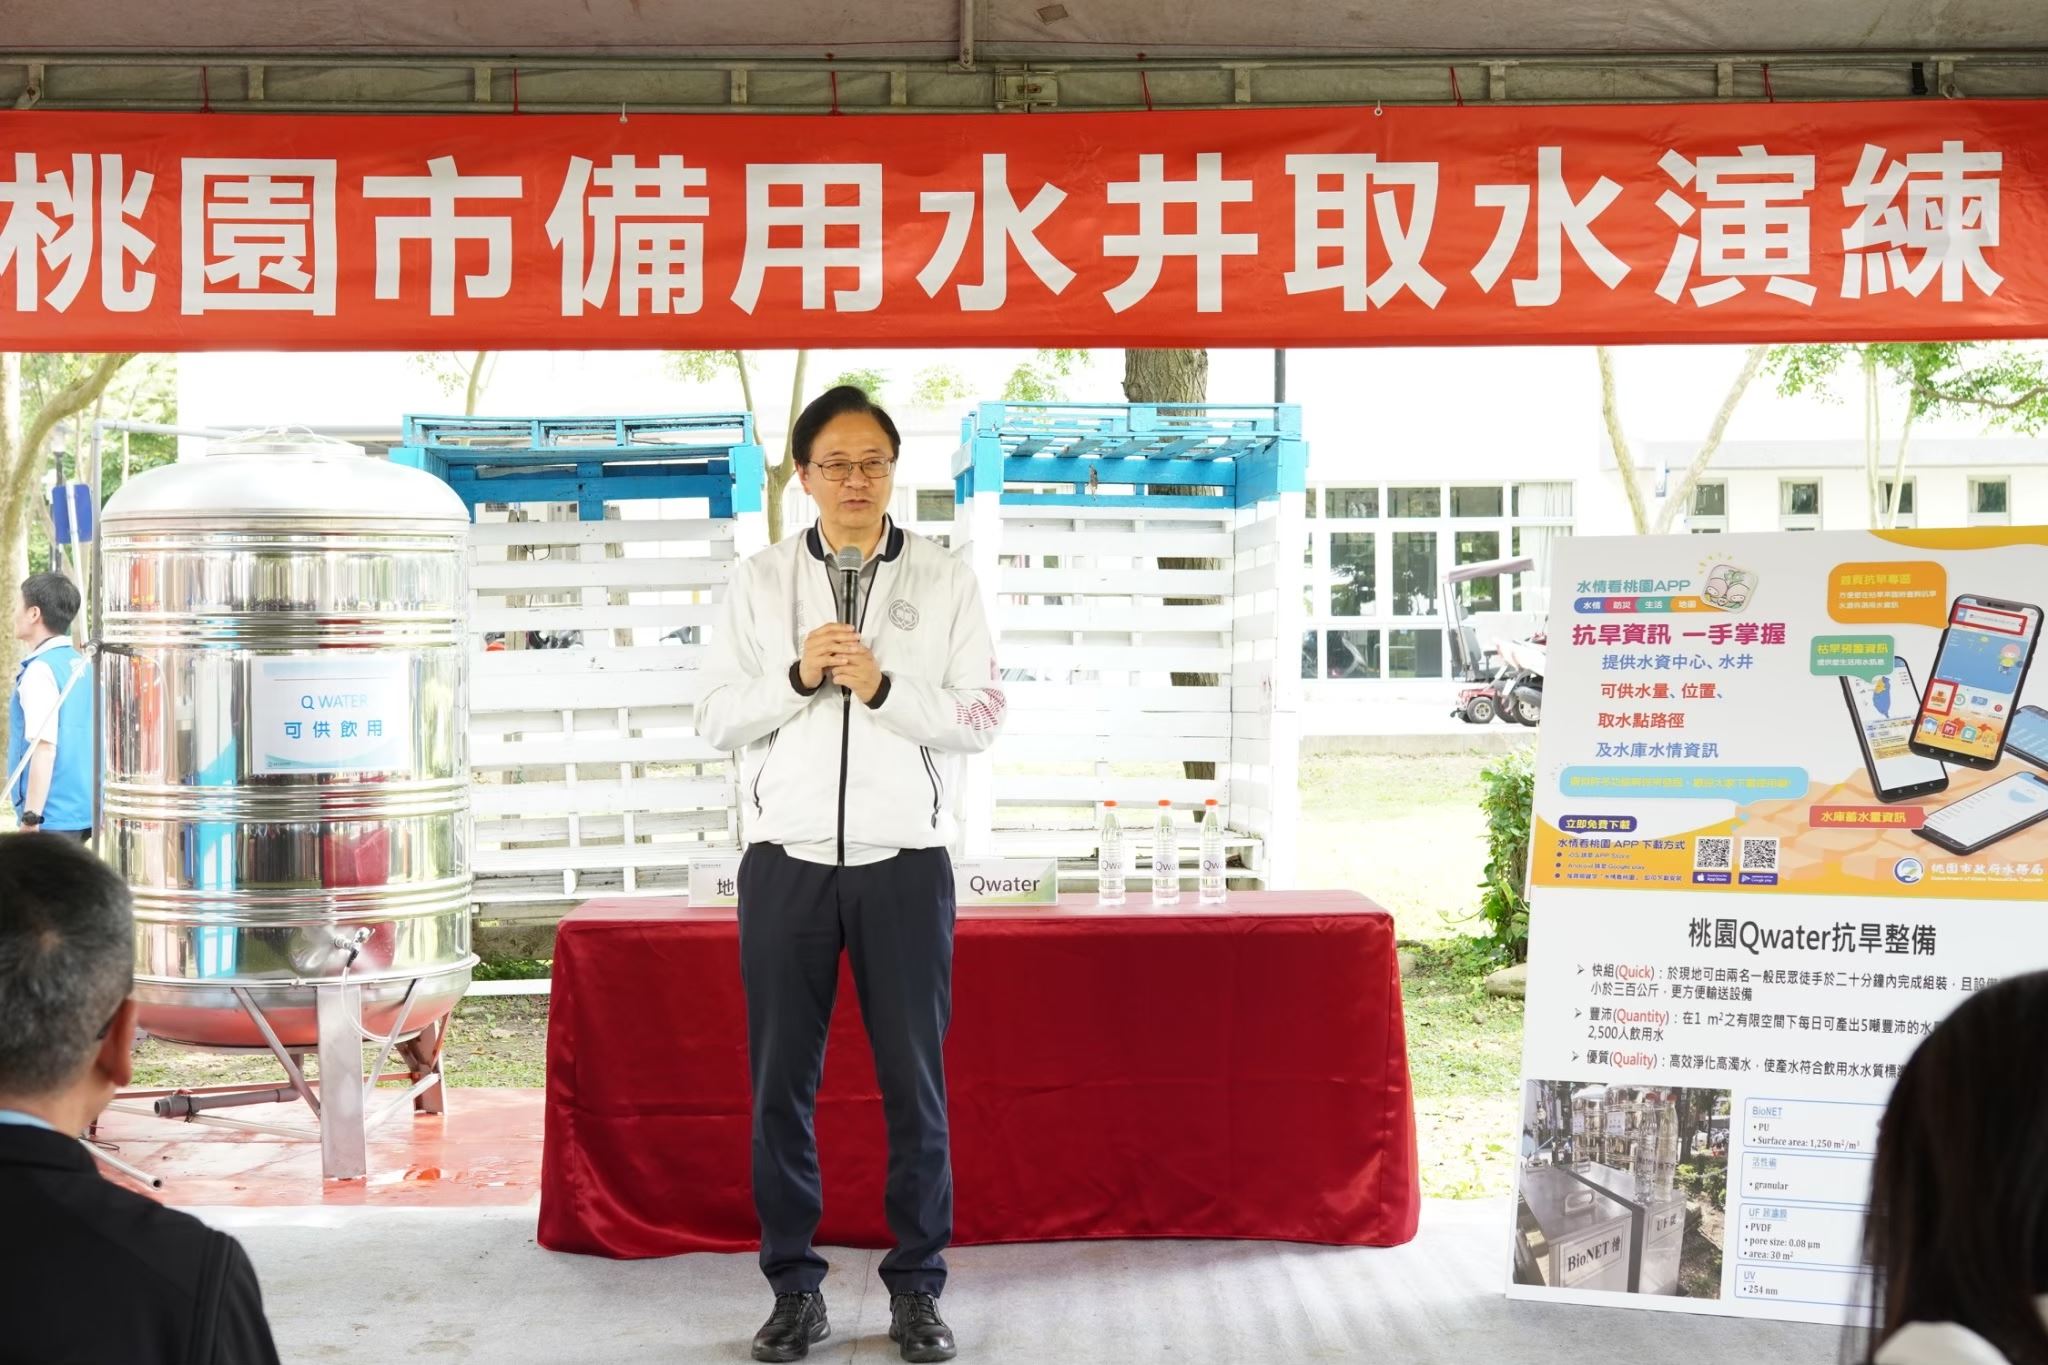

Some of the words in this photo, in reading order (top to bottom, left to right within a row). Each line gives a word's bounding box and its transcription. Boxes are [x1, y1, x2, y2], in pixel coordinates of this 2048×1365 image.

[0, 140, 2005, 317] 桃園市備用水井取水演練
[1576, 578, 1691, 594] 水情看桃園APP
[1644, 601, 1663, 610] 生活
[1572, 623, 1672, 646] 抗旱資訊
[1682, 622, 1786, 646] 一手掌握
[1601, 654, 1754, 671] 提供水資中心、水井
[1600, 682, 1724, 700] 可供水量、位置、
[301, 695, 315, 710] Q
[318, 694, 368, 709] WATER
[1597, 712, 1685, 729] 取水點路徑
[284, 719, 383, 739] 可供飲用
[1595, 742, 1719, 759] 及水庫水情資訊
[1565, 819, 1631, 831] 立即免費下載
[1557, 838, 1611, 850] 水情看桃園
[1614, 839, 1639, 850] APP
[1642, 839, 1686, 851] 下載方式
[716, 878, 735, 896] 地
[969, 875, 1041, 896] Qwater
[1688, 917, 1937, 956] 桃園Qwater抗旱整備
[1587, 1025, 1664, 1042] 2,500人飲用水
[1752, 1106, 1783, 1117] BioNET
[1758, 1122, 1770, 1132] PU
[1757, 1136, 1787, 1146] Surface
[1787, 1139, 1808, 1148] area:
[1810, 1139, 1833, 1149] 1,250
[1754, 1181, 1788, 1191] granular
[1748, 1208, 1761, 1217] UF
[1750, 1223, 1772, 1233] PVDF
[1750, 1238, 1768, 1247] pore
[1768, 1237, 1787, 1247] size:
[1788, 1239, 1806, 1249] 0.08
[1567, 1240, 1610, 1272] BioNET
[1749, 1252, 1769, 1260] area:
[1770, 1251, 1781, 1260] 30
[1743, 1271, 1756, 1280] UV
[1748, 1285, 1764, 1295] 254
[1765, 1287, 1778, 1296] nm
